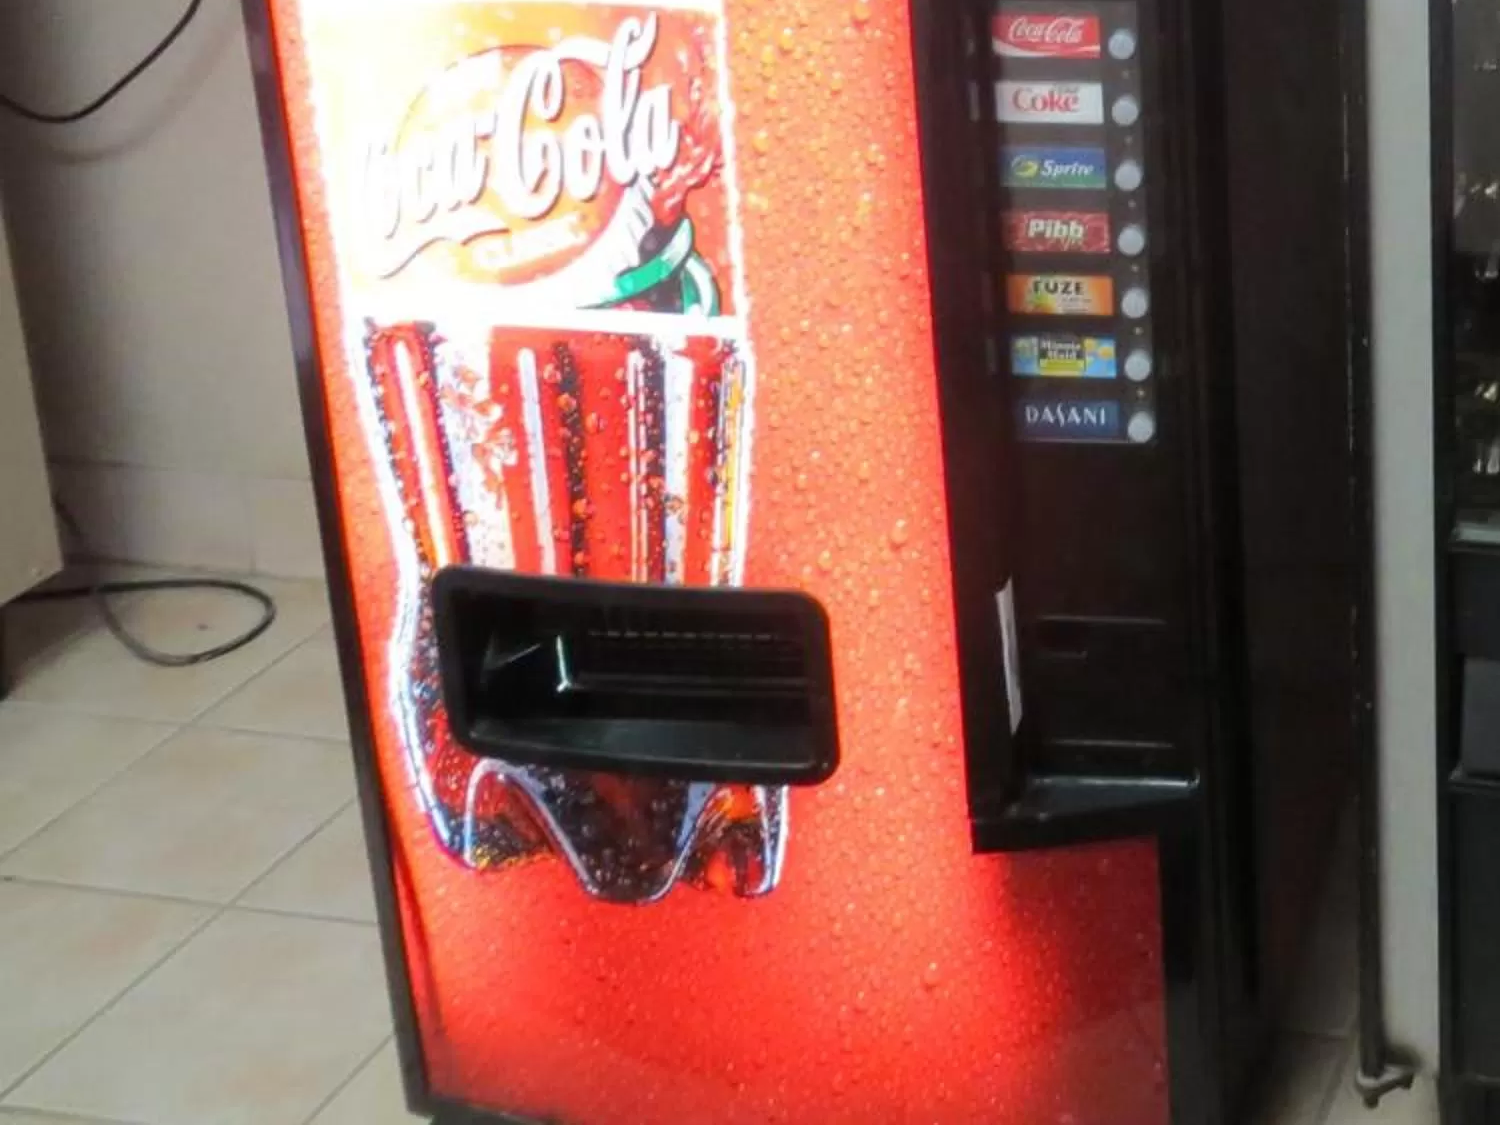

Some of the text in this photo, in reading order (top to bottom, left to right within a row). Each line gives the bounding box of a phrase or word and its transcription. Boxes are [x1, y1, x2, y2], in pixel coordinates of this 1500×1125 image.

[1008, 16, 1085, 43] Coca-Cola
[1012, 86, 1080, 112] Coke
[1041, 159, 1094, 177] Sprite
[1027, 217, 1085, 239] Pibb
[1033, 279, 1085, 296] FUZE
[1025, 404, 1106, 428] DASANI
